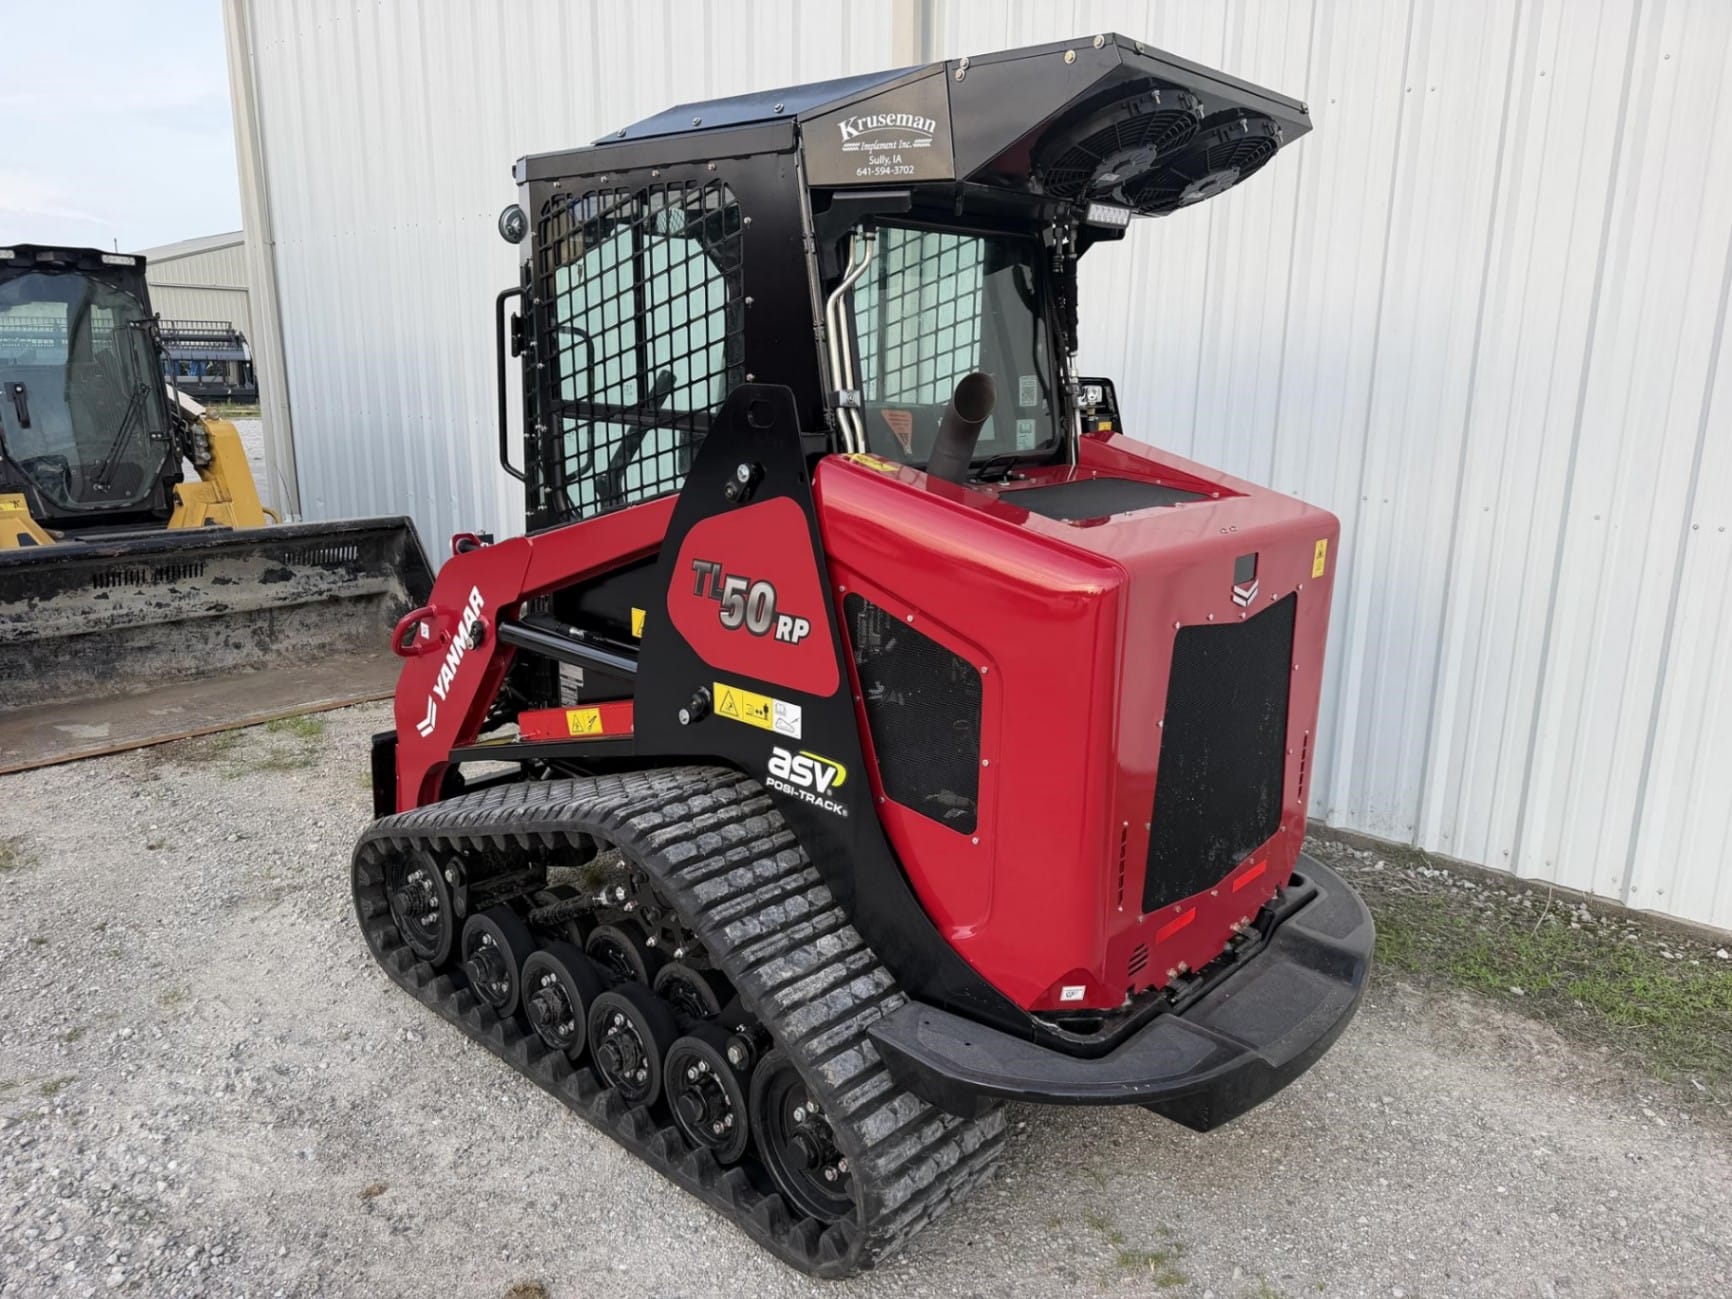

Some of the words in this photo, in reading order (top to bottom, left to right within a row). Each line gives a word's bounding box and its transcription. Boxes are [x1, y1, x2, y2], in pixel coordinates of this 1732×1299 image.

[837, 113, 936, 141] Kruseman
[861, 140, 897, 154] Implement
[899, 140, 912, 149] Inc.
[869, 155, 891, 166] Sully,
[893, 154, 902, 163] IA
[856, 165, 914, 176] 641-594-3702
[433, 585, 485, 701] YANMAR
